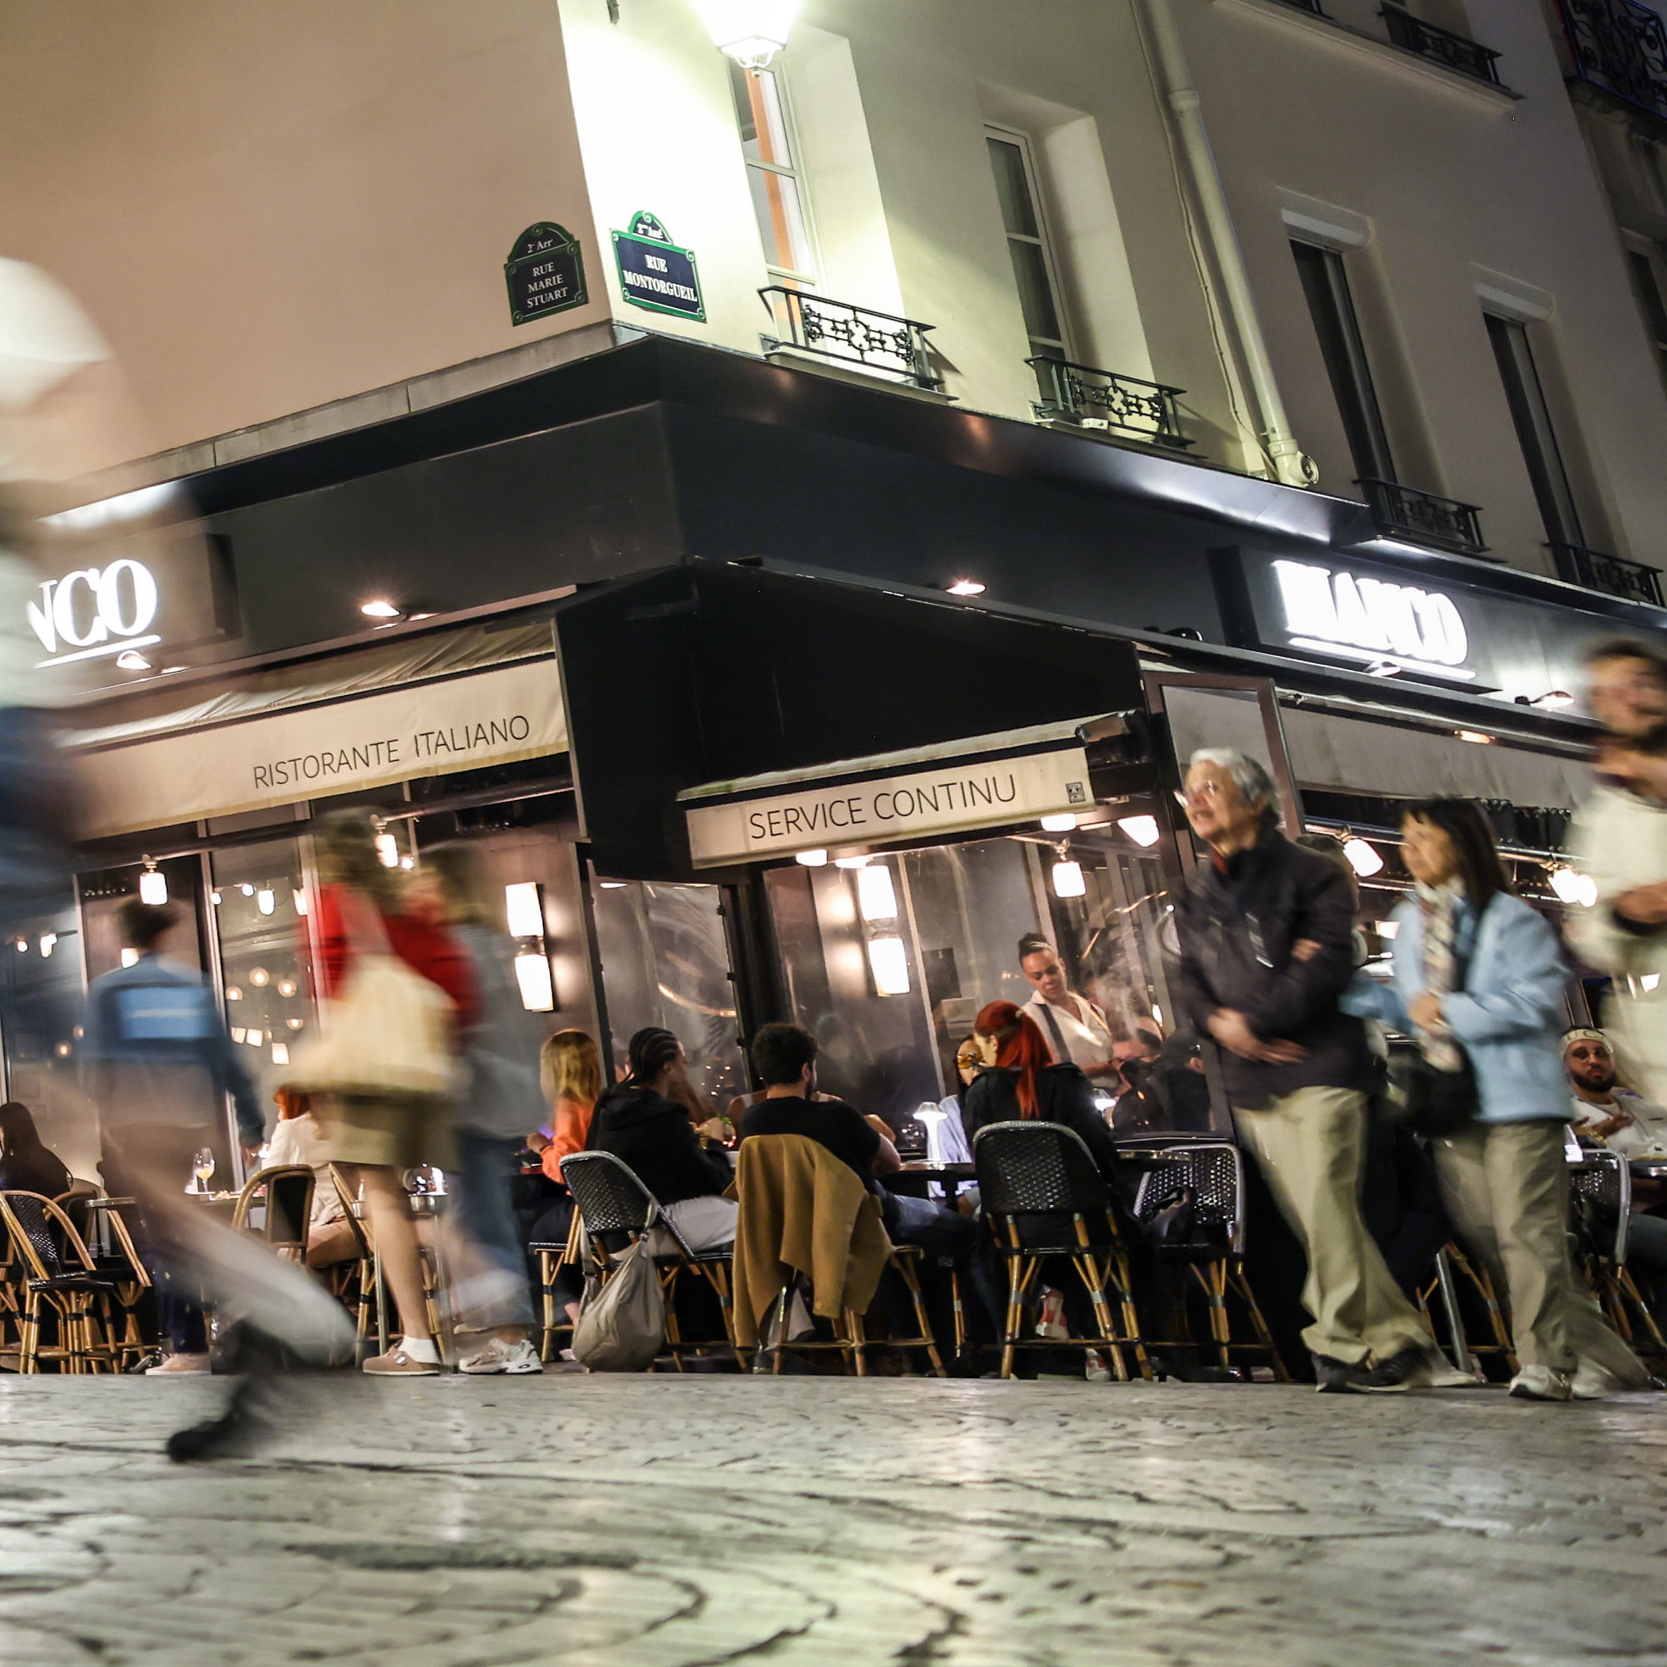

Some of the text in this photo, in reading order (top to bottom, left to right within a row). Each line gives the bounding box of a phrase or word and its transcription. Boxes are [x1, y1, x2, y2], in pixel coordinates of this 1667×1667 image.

[532, 262, 555, 277] RUE
[644, 254, 668, 273] RUE
[527, 274, 564, 293] MARIE
[622, 269, 698, 302] MONTORGUEIL
[527, 287, 568, 308] STUART
[252, 714, 531, 790] RISTORANTE ITALIANO
[749, 774, 1017, 840] SERVICE CONTINU
